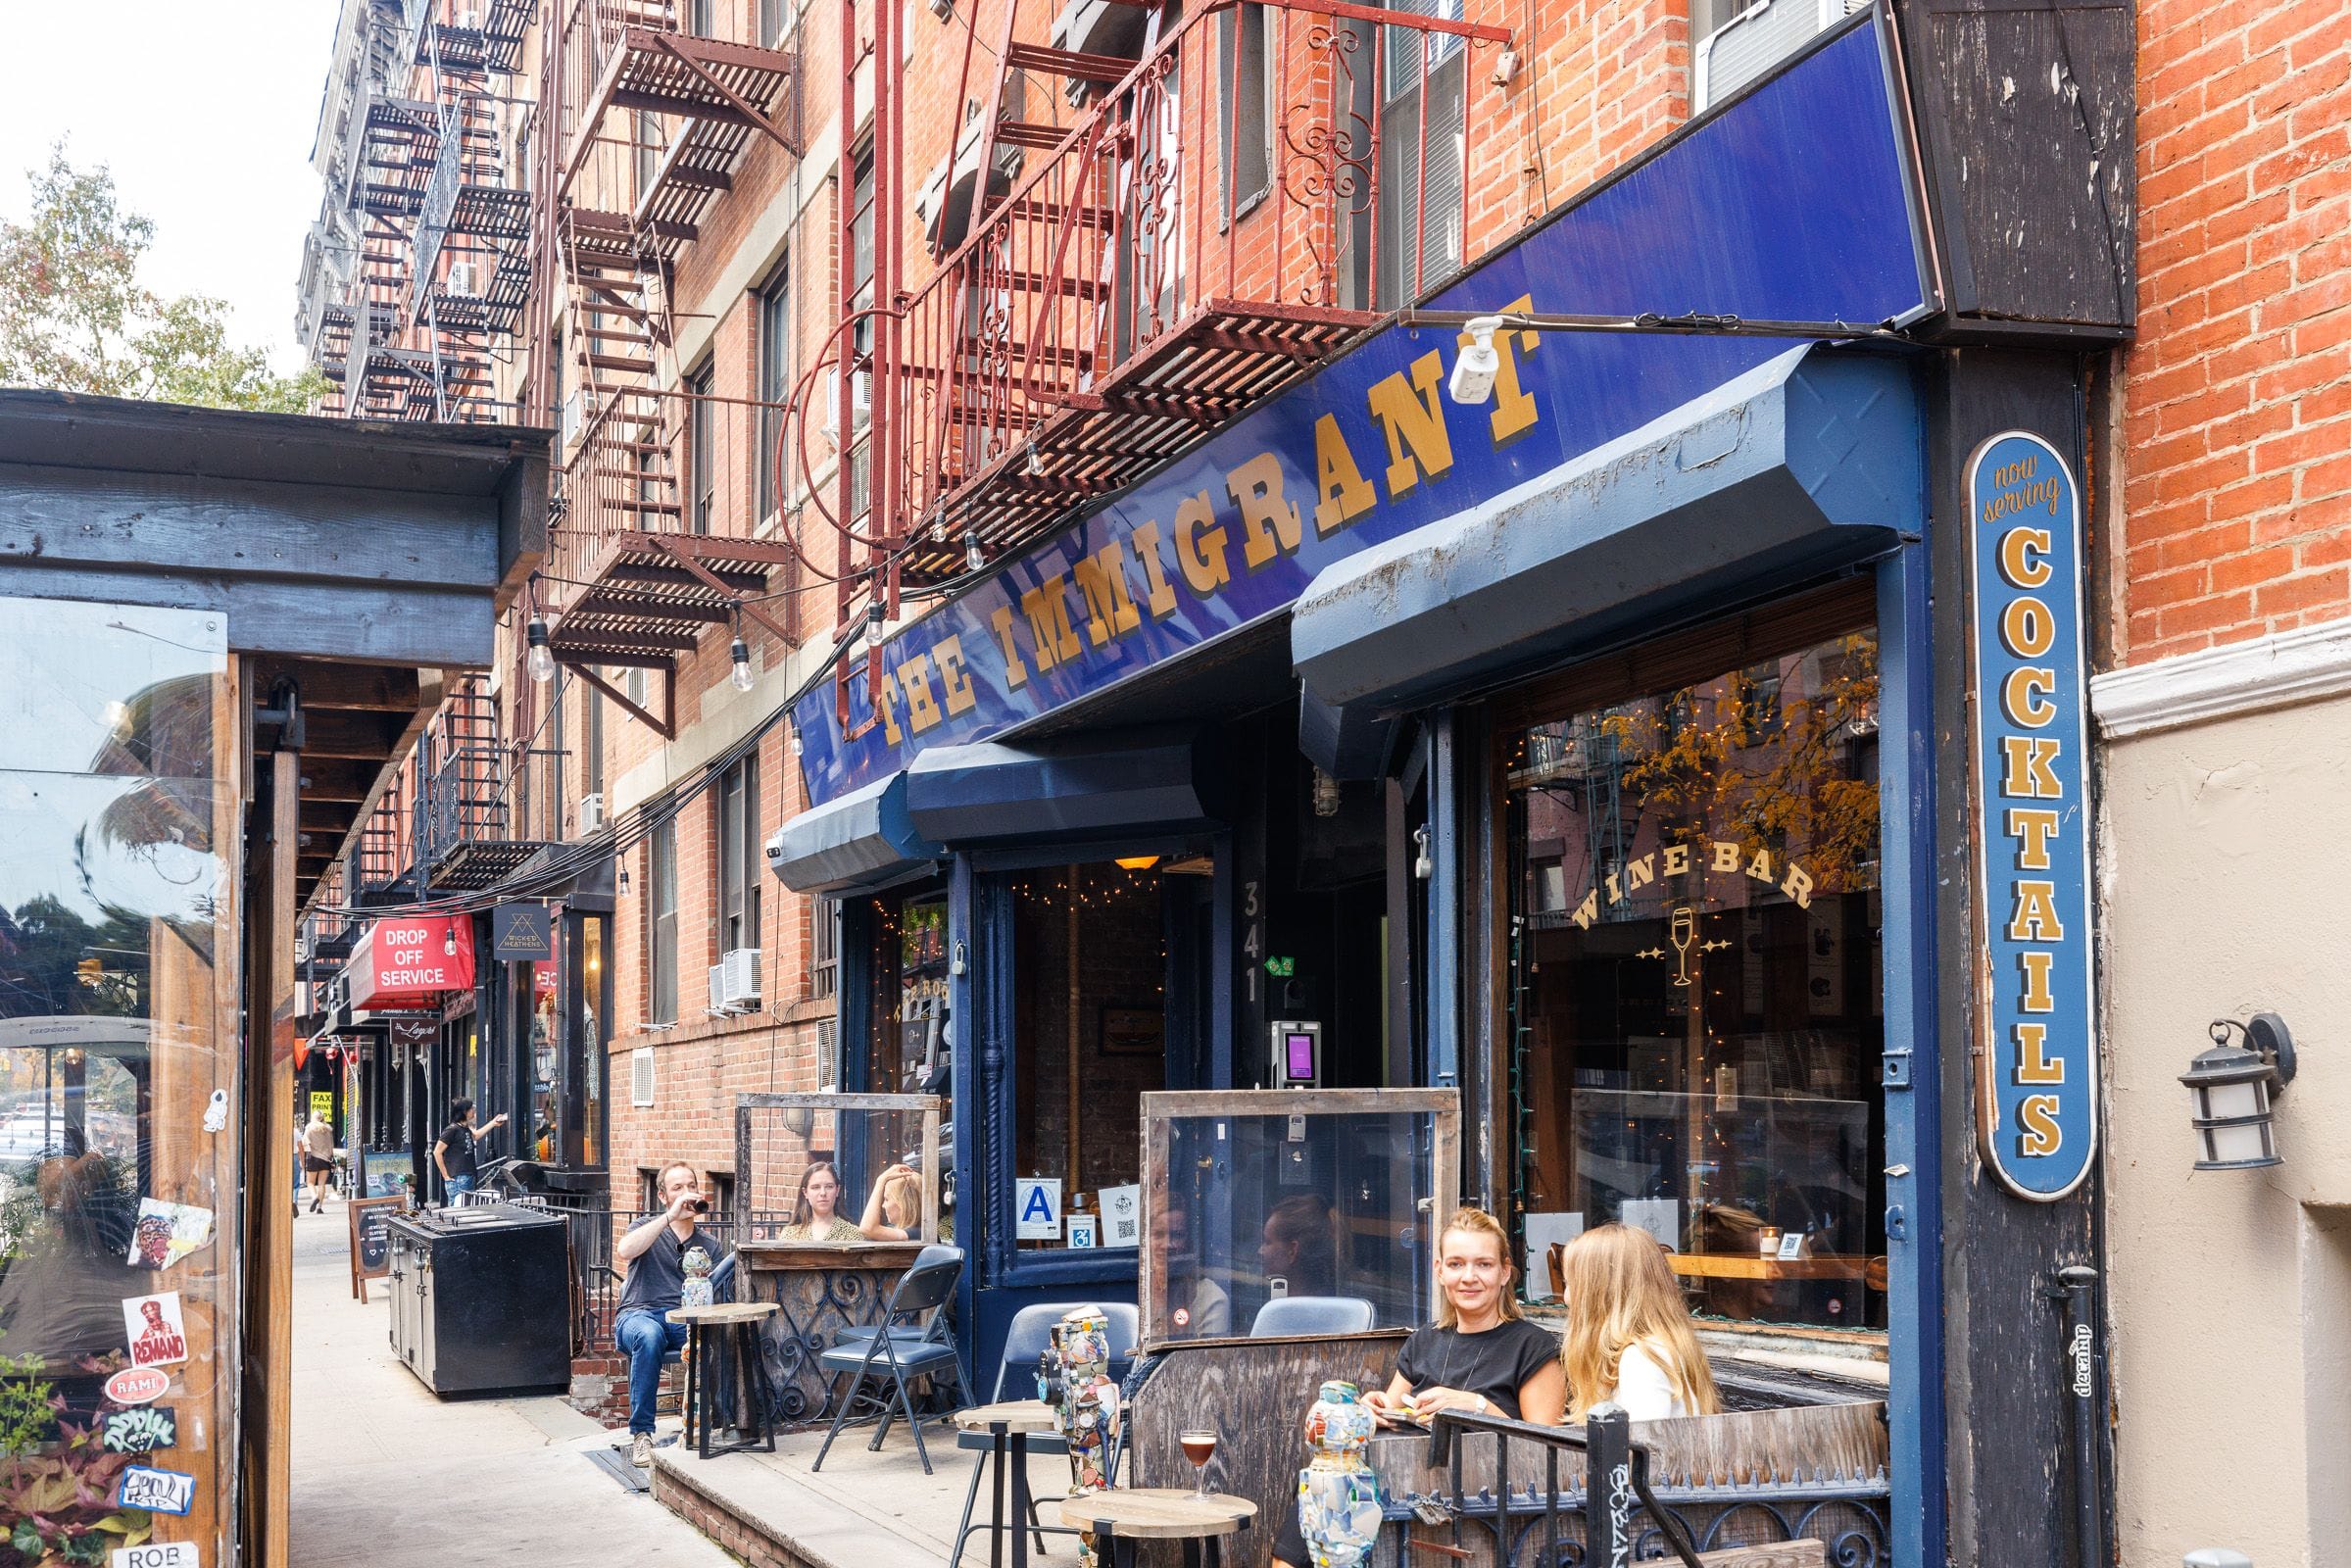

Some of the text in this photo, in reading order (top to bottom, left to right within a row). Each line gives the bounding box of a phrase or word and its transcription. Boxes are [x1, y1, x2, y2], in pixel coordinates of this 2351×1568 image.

[1994, 454, 2038, 489] now
[1983, 475, 2062, 523] serving
[881, 293, 1542, 747] THE IMMIGRANT
[1997, 525, 2066, 1157] COCKTAILS
[1571, 841, 1814, 931] WINE BAR
[385, 929, 428, 947] DROP
[1244, 881, 1259, 1003] 341
[394, 950, 424, 966] OFF
[380, 968, 445, 987] SERVICE
[313, 1094, 331, 1102] FAX
[1021, 1186, 1053, 1222] A
[2074, 1325, 2092, 1396] decamp
[116, 1377, 158, 1394] RAMI
[128, 1546, 180, 1568] ROB
